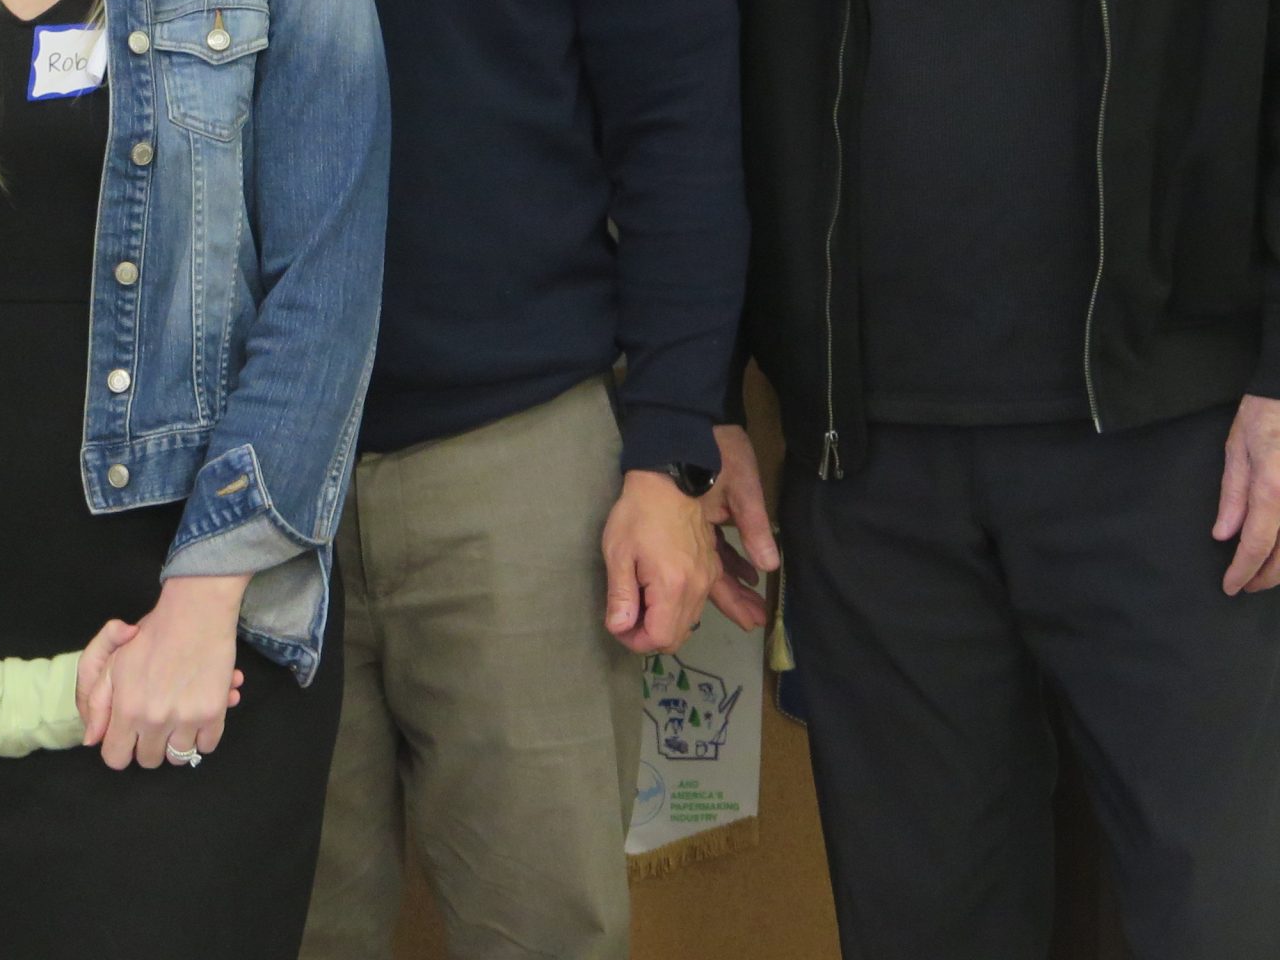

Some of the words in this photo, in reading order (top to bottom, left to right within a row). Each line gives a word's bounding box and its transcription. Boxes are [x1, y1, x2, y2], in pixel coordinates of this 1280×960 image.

[677, 780, 699, 789] AND
[671, 791, 724, 800] AMERICA'S
[670, 802, 740, 811] PAPERMAKING
[670, 813, 718, 822] INDUSTRY
